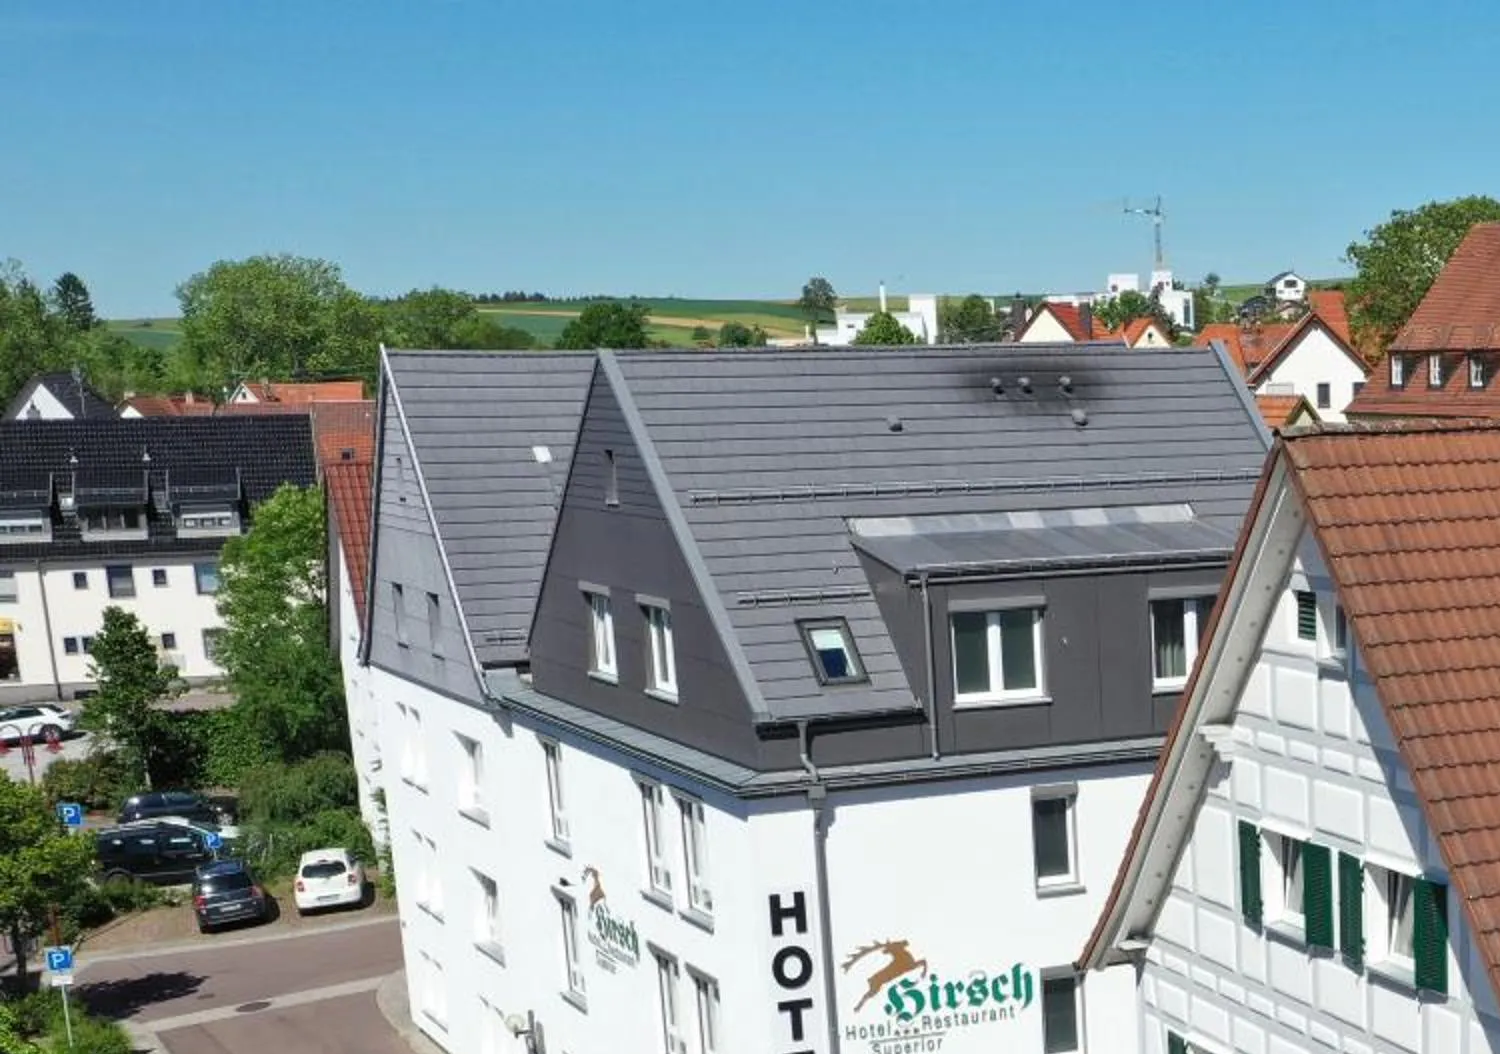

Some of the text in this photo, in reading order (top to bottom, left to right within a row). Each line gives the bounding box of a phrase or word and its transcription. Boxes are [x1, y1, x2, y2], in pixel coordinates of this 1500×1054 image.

[884, 962, 1033, 1023] Hirsch
[845, 1005, 1016, 1041] Hotel Restaurant
